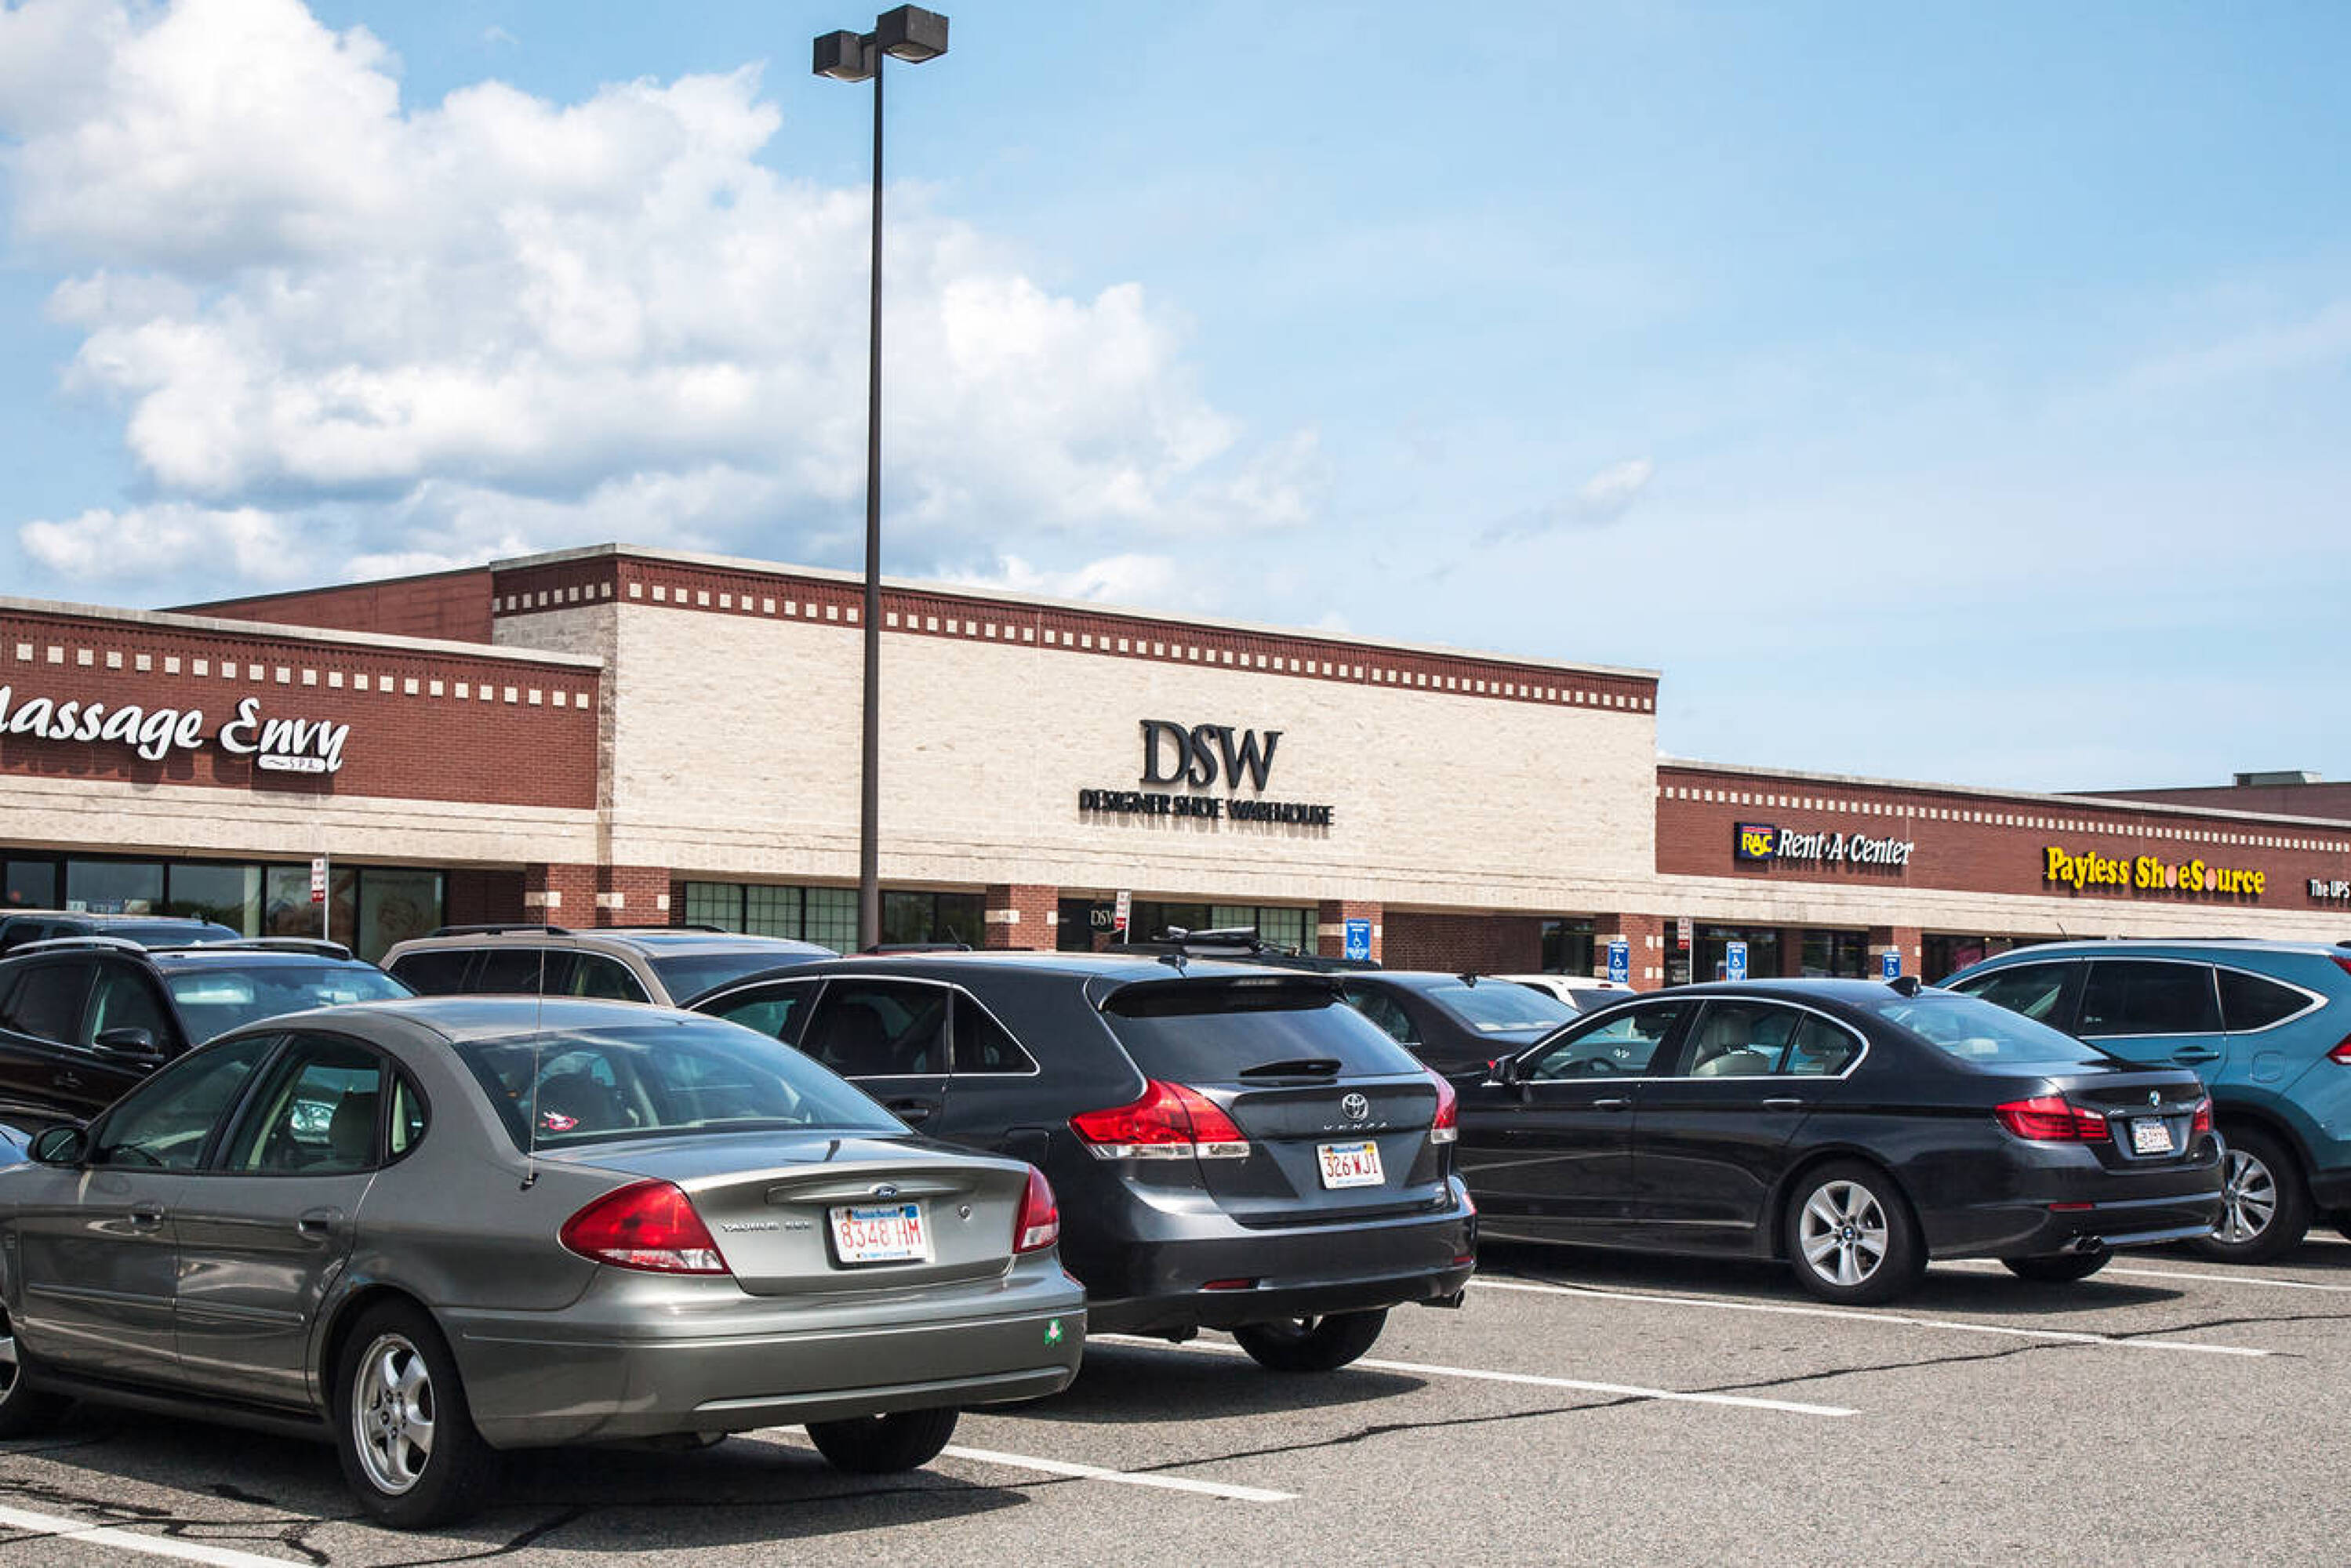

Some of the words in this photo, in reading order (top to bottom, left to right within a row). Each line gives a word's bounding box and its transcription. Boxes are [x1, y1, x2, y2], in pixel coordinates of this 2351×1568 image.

[220, 697, 349, 772] Envy
[1139, 719, 1283, 792] DSW
[1079, 789, 1171, 815] DESIGNER
[1173, 794, 1223, 819] SHOE
[1226, 800, 1335, 826] WAREHOUSE
[2047, 847, 2130, 890] Payless
[2309, 879, 2329, 897] The
[2330, 880, 2350, 898] UPS
[841, 1219, 891, 1249] 8348
[894, 1218, 921, 1245] HM
